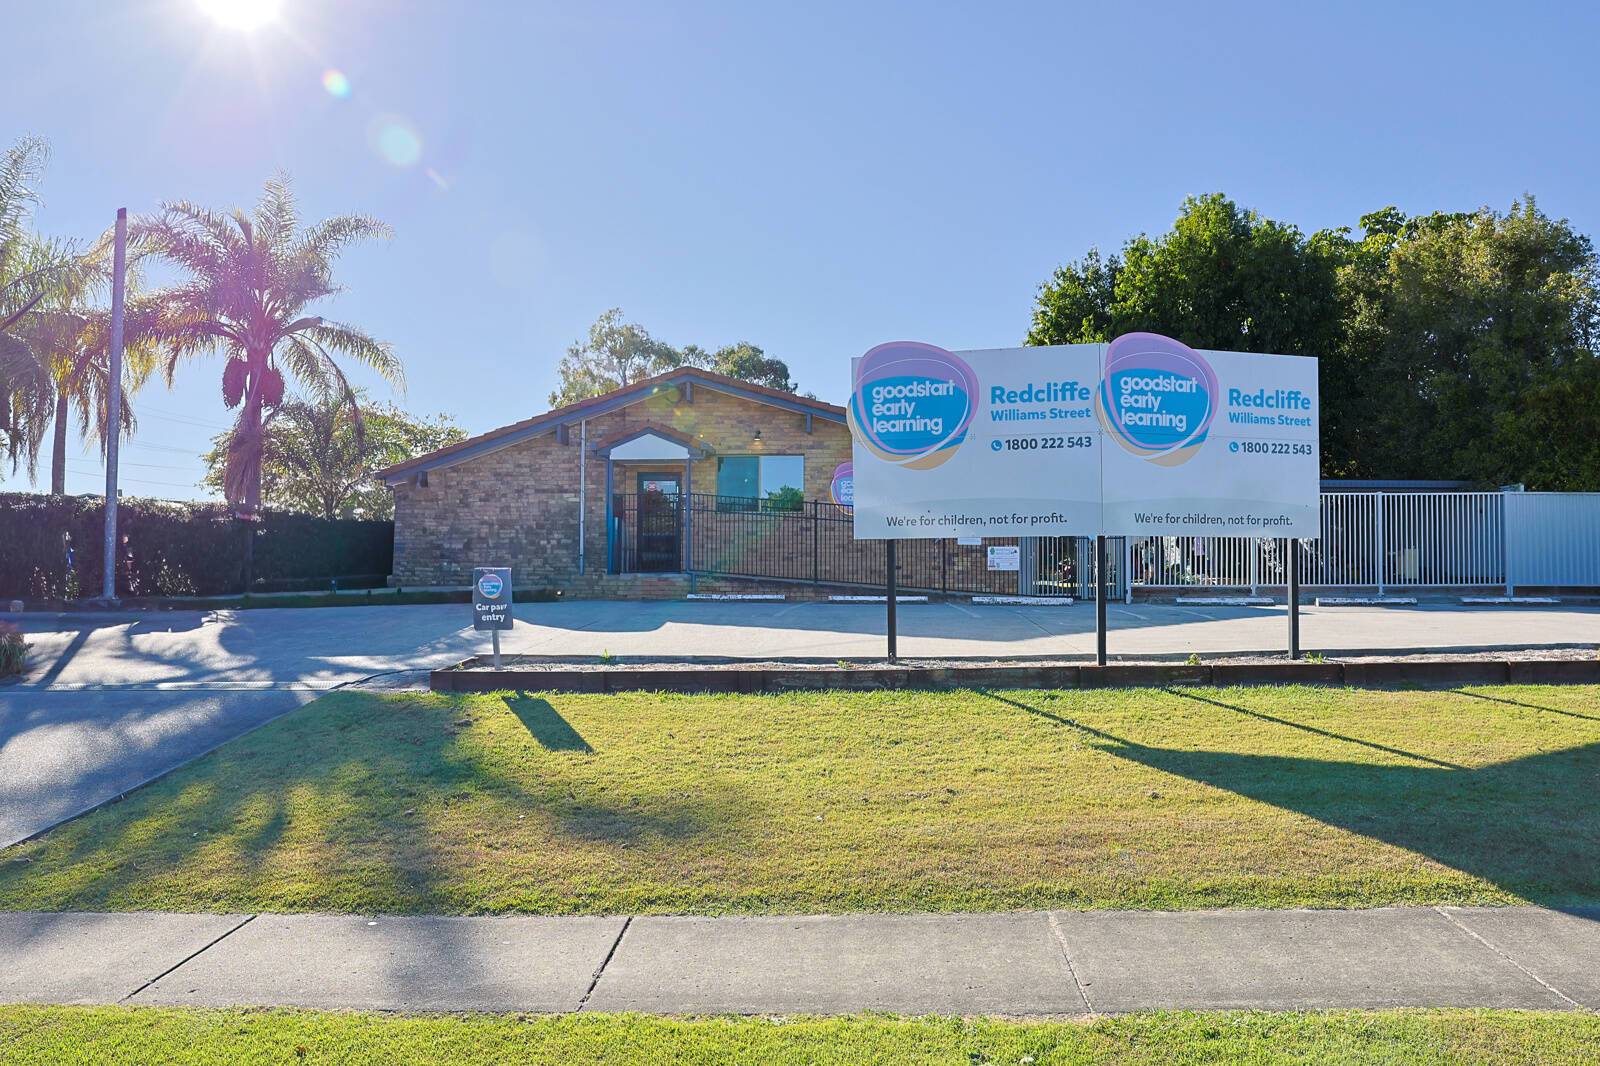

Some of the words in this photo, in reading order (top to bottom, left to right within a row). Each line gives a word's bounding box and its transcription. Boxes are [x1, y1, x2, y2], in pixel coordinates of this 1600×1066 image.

[872, 380, 955, 403] goodstart
[991, 381, 1090, 404] Redcliffe
[1120, 375, 1197, 394] goodstart
[1120, 392, 1161, 412] early
[1228, 388, 1311, 410] Redcliffe
[872, 399, 916, 418] early
[991, 408, 1046, 421] Williams
[1049, 407, 1091, 419] Street
[873, 416, 943, 435] learning
[1121, 408, 1187, 432] learning
[1228, 411, 1276, 425] Williams
[1277, 414, 1311, 426] Street
[1005, 438, 1038, 451] 1800
[1041, 437, 1064, 449] 222
[1067, 436, 1092, 448] 543
[1241, 442, 1269, 453] 1800
[1271, 443, 1290, 454] 222
[1292, 443, 1312, 455] 543
[886, 516, 917, 527] We're
[919, 515, 935, 526] for
[938, 514, 987, 527] children,
[989, 514, 1008, 525] not
[1011, 513, 1028, 525] for
[1031, 512, 1068, 526] profit.
[1134, 512, 1163, 524] We're
[1165, 513, 1180, 524] for
[1182, 513, 1226, 526] children,
[1227, 514, 1245, 525] not
[1247, 514, 1261, 525] for
[1263, 515, 1293, 528] profit.
[475, 603, 489, 611] Car
[481, 613, 505, 622] entry
